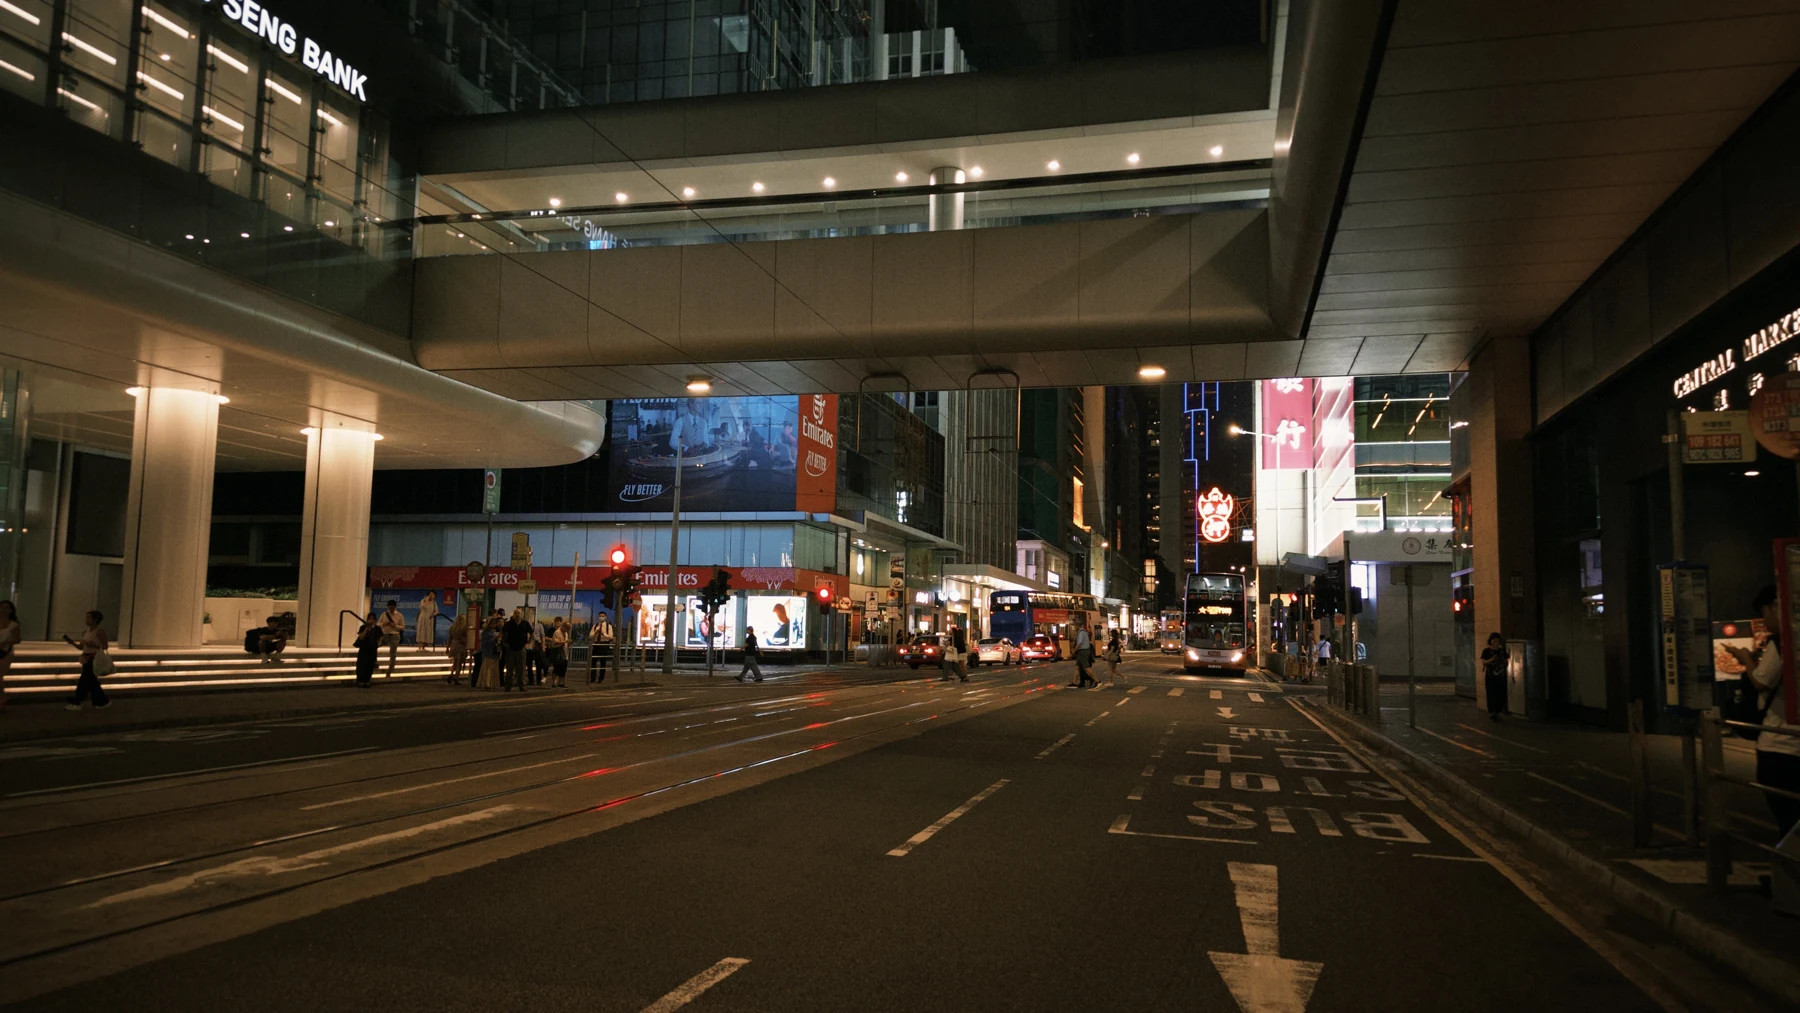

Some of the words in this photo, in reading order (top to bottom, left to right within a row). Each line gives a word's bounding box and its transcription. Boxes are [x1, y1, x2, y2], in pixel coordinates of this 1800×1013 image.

[223, 0, 297, 54] SENG
[303, 37, 368, 102] BANK
[1674, 349, 1736, 399] CENTRAL
[803, 415, 834, 449] Emirates
[814, 453, 827, 472] BETTER
[624, 484, 636, 495] FLY
[637, 484, 662, 495] BETTER
[636, 571, 698, 585] Emirtes
[541, 594, 550, 602] FEEL
[550, 594, 558, 602] ON
[558, 594, 566, 602] TOP
[1172, 769, 1408, 801] STOP
[1187, 801, 1431, 844] BUS
